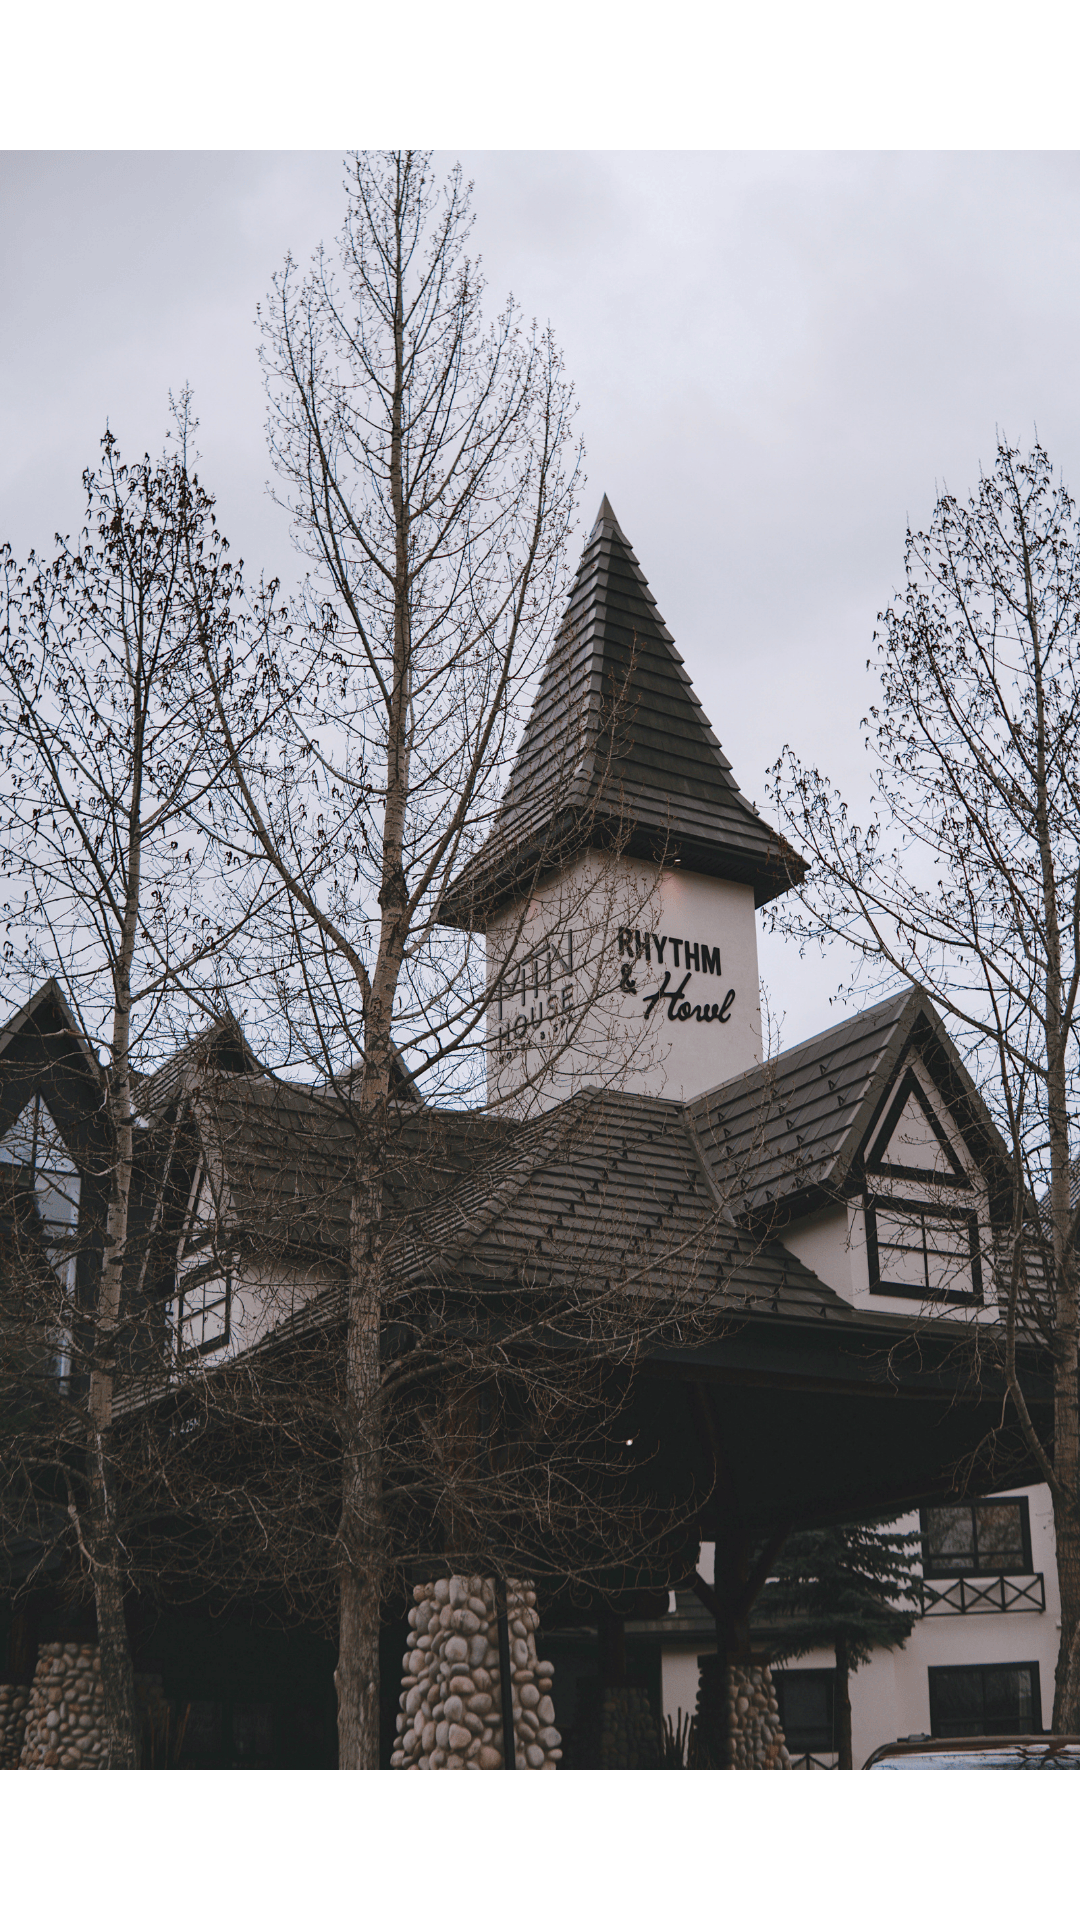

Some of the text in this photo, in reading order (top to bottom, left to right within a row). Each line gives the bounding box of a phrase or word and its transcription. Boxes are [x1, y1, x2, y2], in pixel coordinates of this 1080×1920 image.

[618, 926, 721, 976] RHYTHM
[498, 983, 574, 1051] HOUSE
[620, 963, 735, 1023] & Howl
